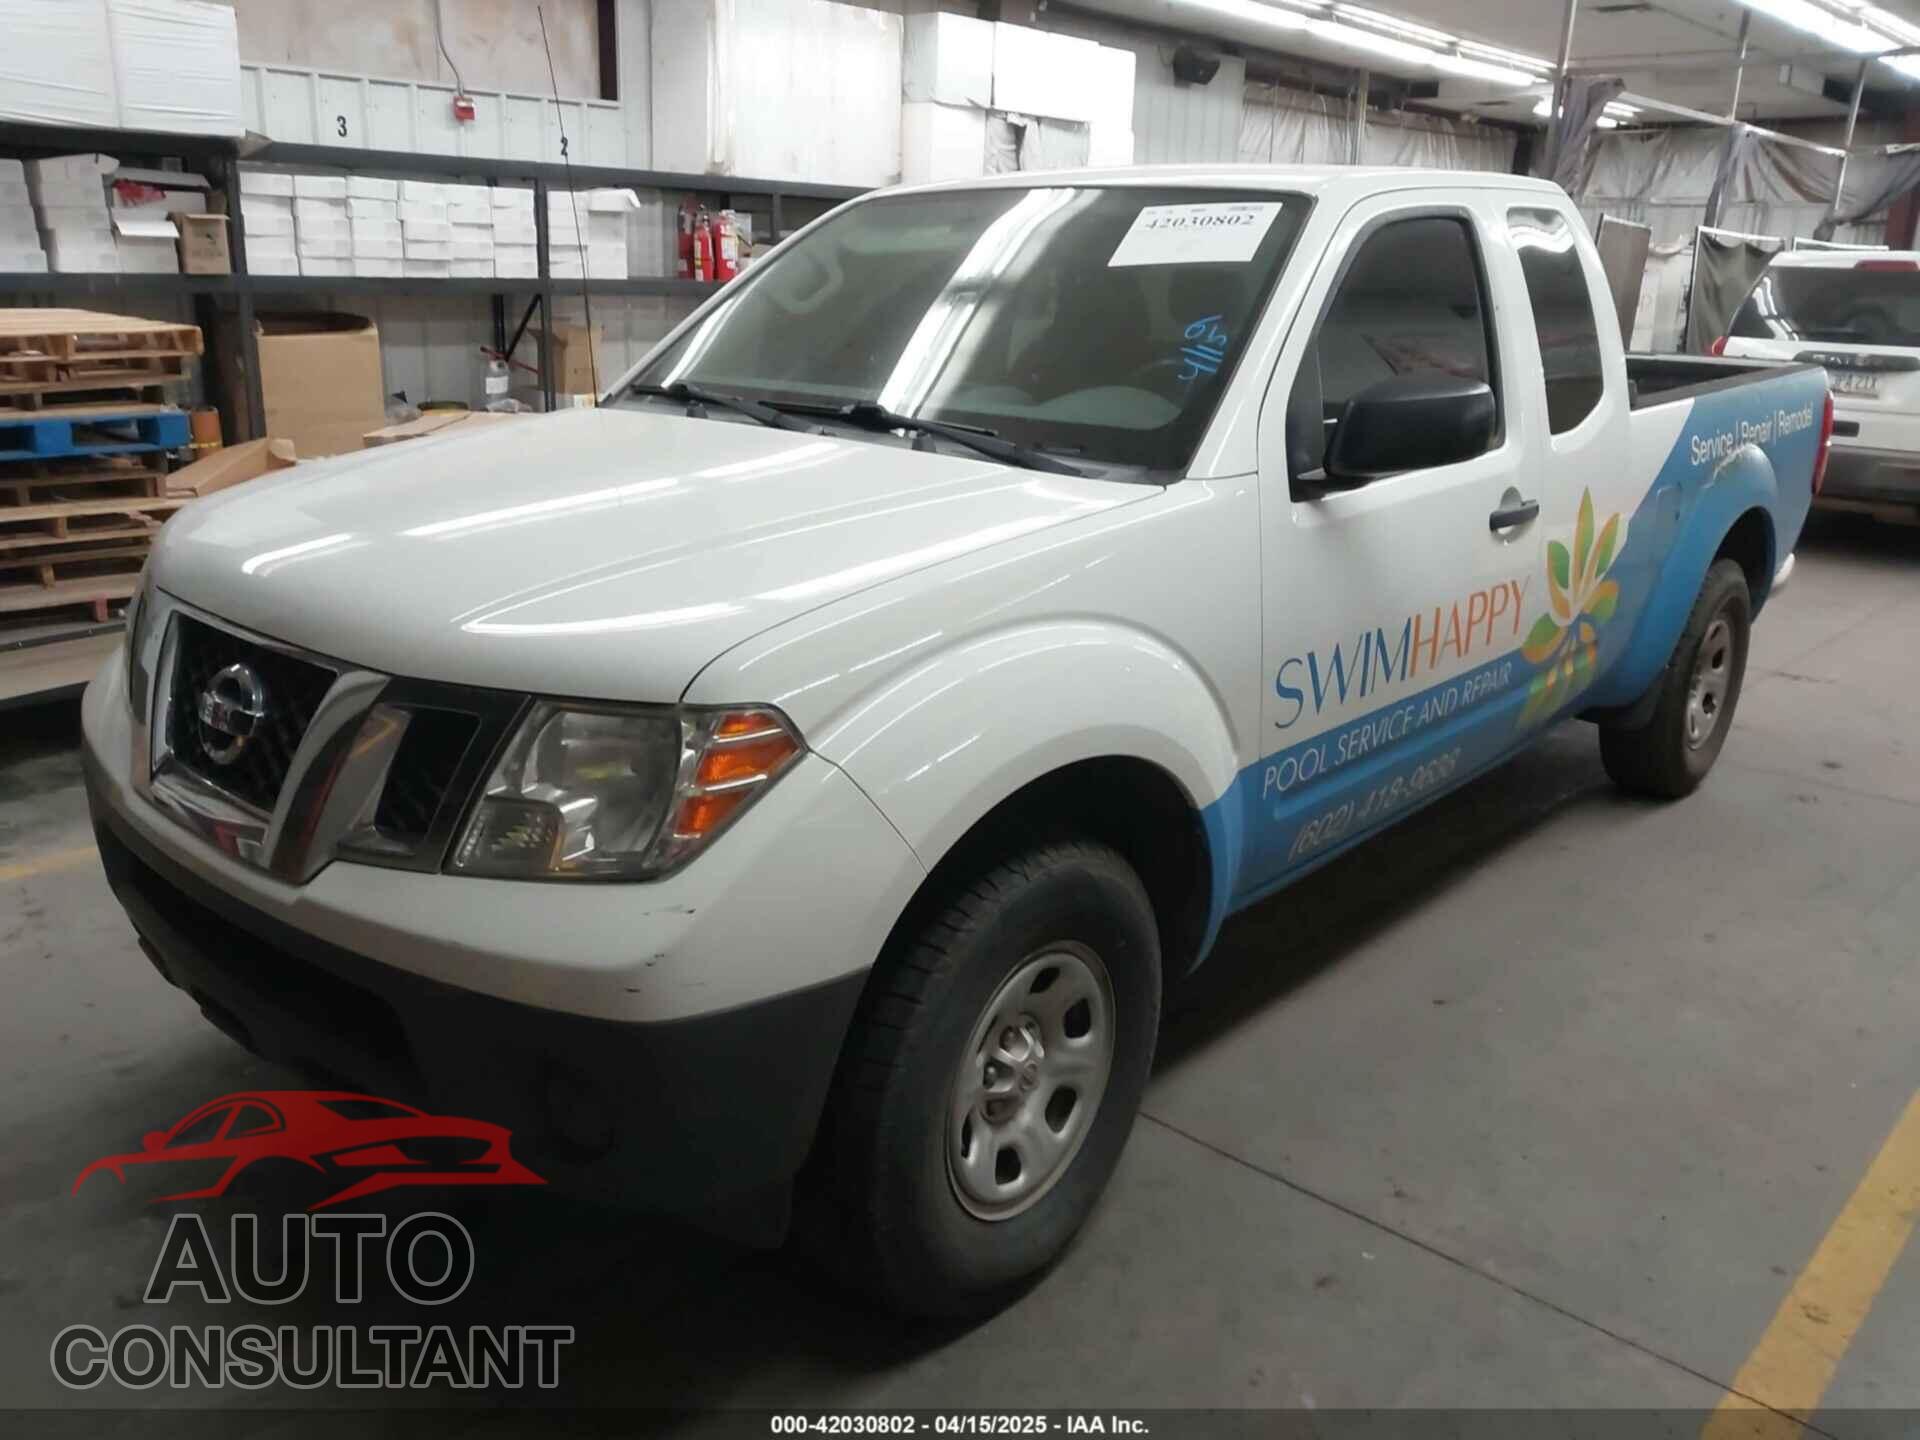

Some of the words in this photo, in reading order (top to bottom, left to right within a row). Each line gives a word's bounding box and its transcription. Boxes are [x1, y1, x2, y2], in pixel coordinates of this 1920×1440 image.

[336, 115, 348, 138] 3
[560, 136, 569, 156] 2
[1145, 214, 1256, 229] 42030802
[1690, 430, 1734, 466] Service
[1778, 401, 1814, 438] Remodel
[1263, 744, 1327, 800] POOL
[1335, 704, 1415, 766] SERVICE
[1416, 687, 1458, 729] AND
[1462, 661, 1513, 707] REPAIR
